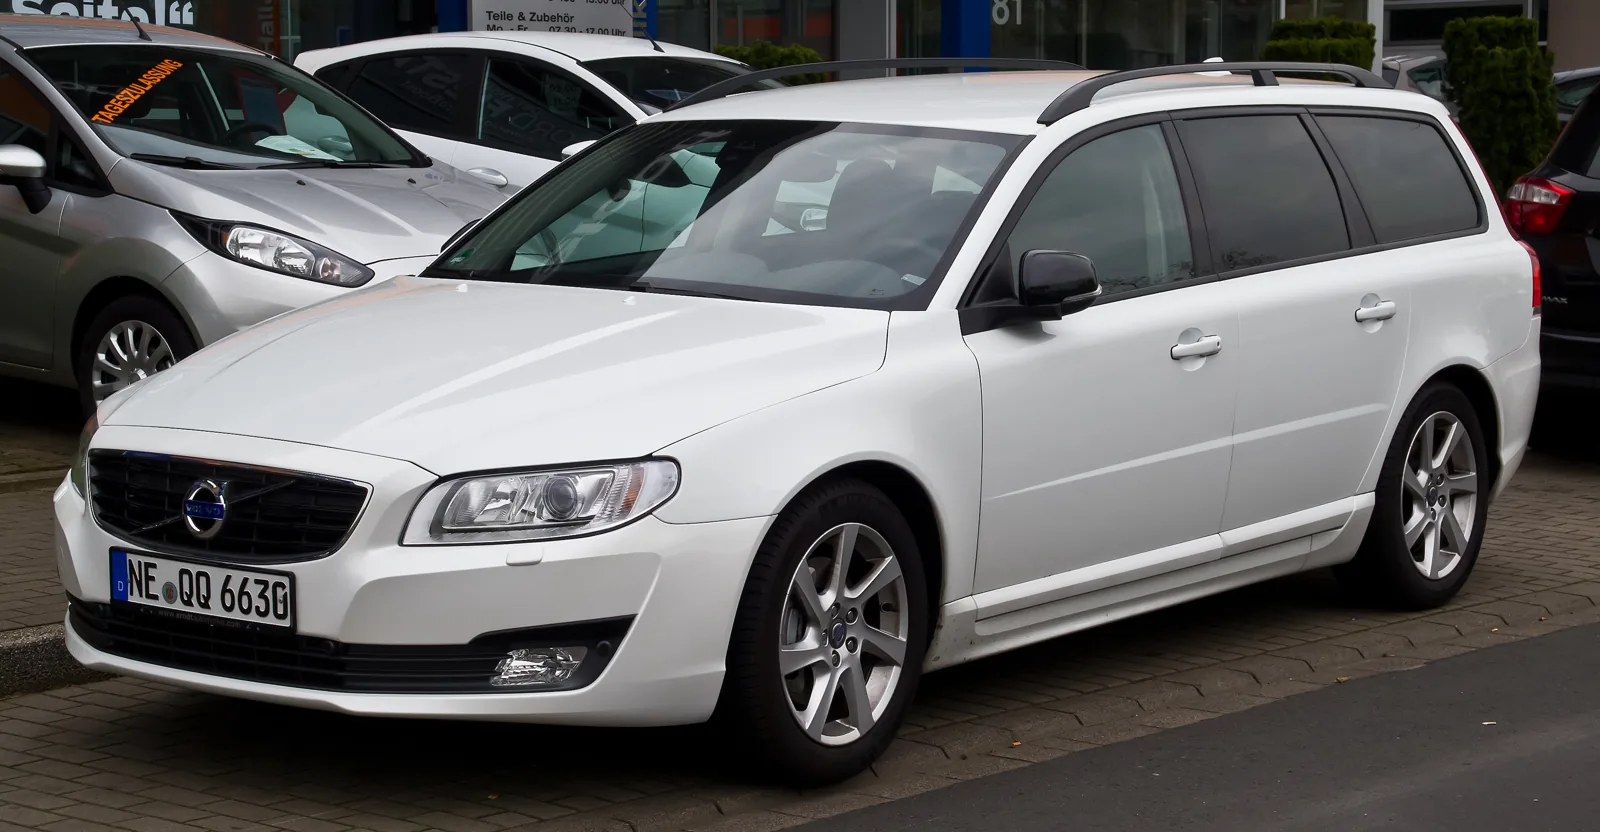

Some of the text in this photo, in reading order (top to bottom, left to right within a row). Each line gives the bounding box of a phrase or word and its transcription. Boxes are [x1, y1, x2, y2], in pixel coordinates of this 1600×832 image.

[486, 11, 575, 23] Teile & Zubehör
[992, 0, 1022, 25] 81
[91, 59, 183, 124] TAGESZULASSUNG
[117, 580, 125, 592] D
[128, 558, 288, 621] NE QQ 6630
